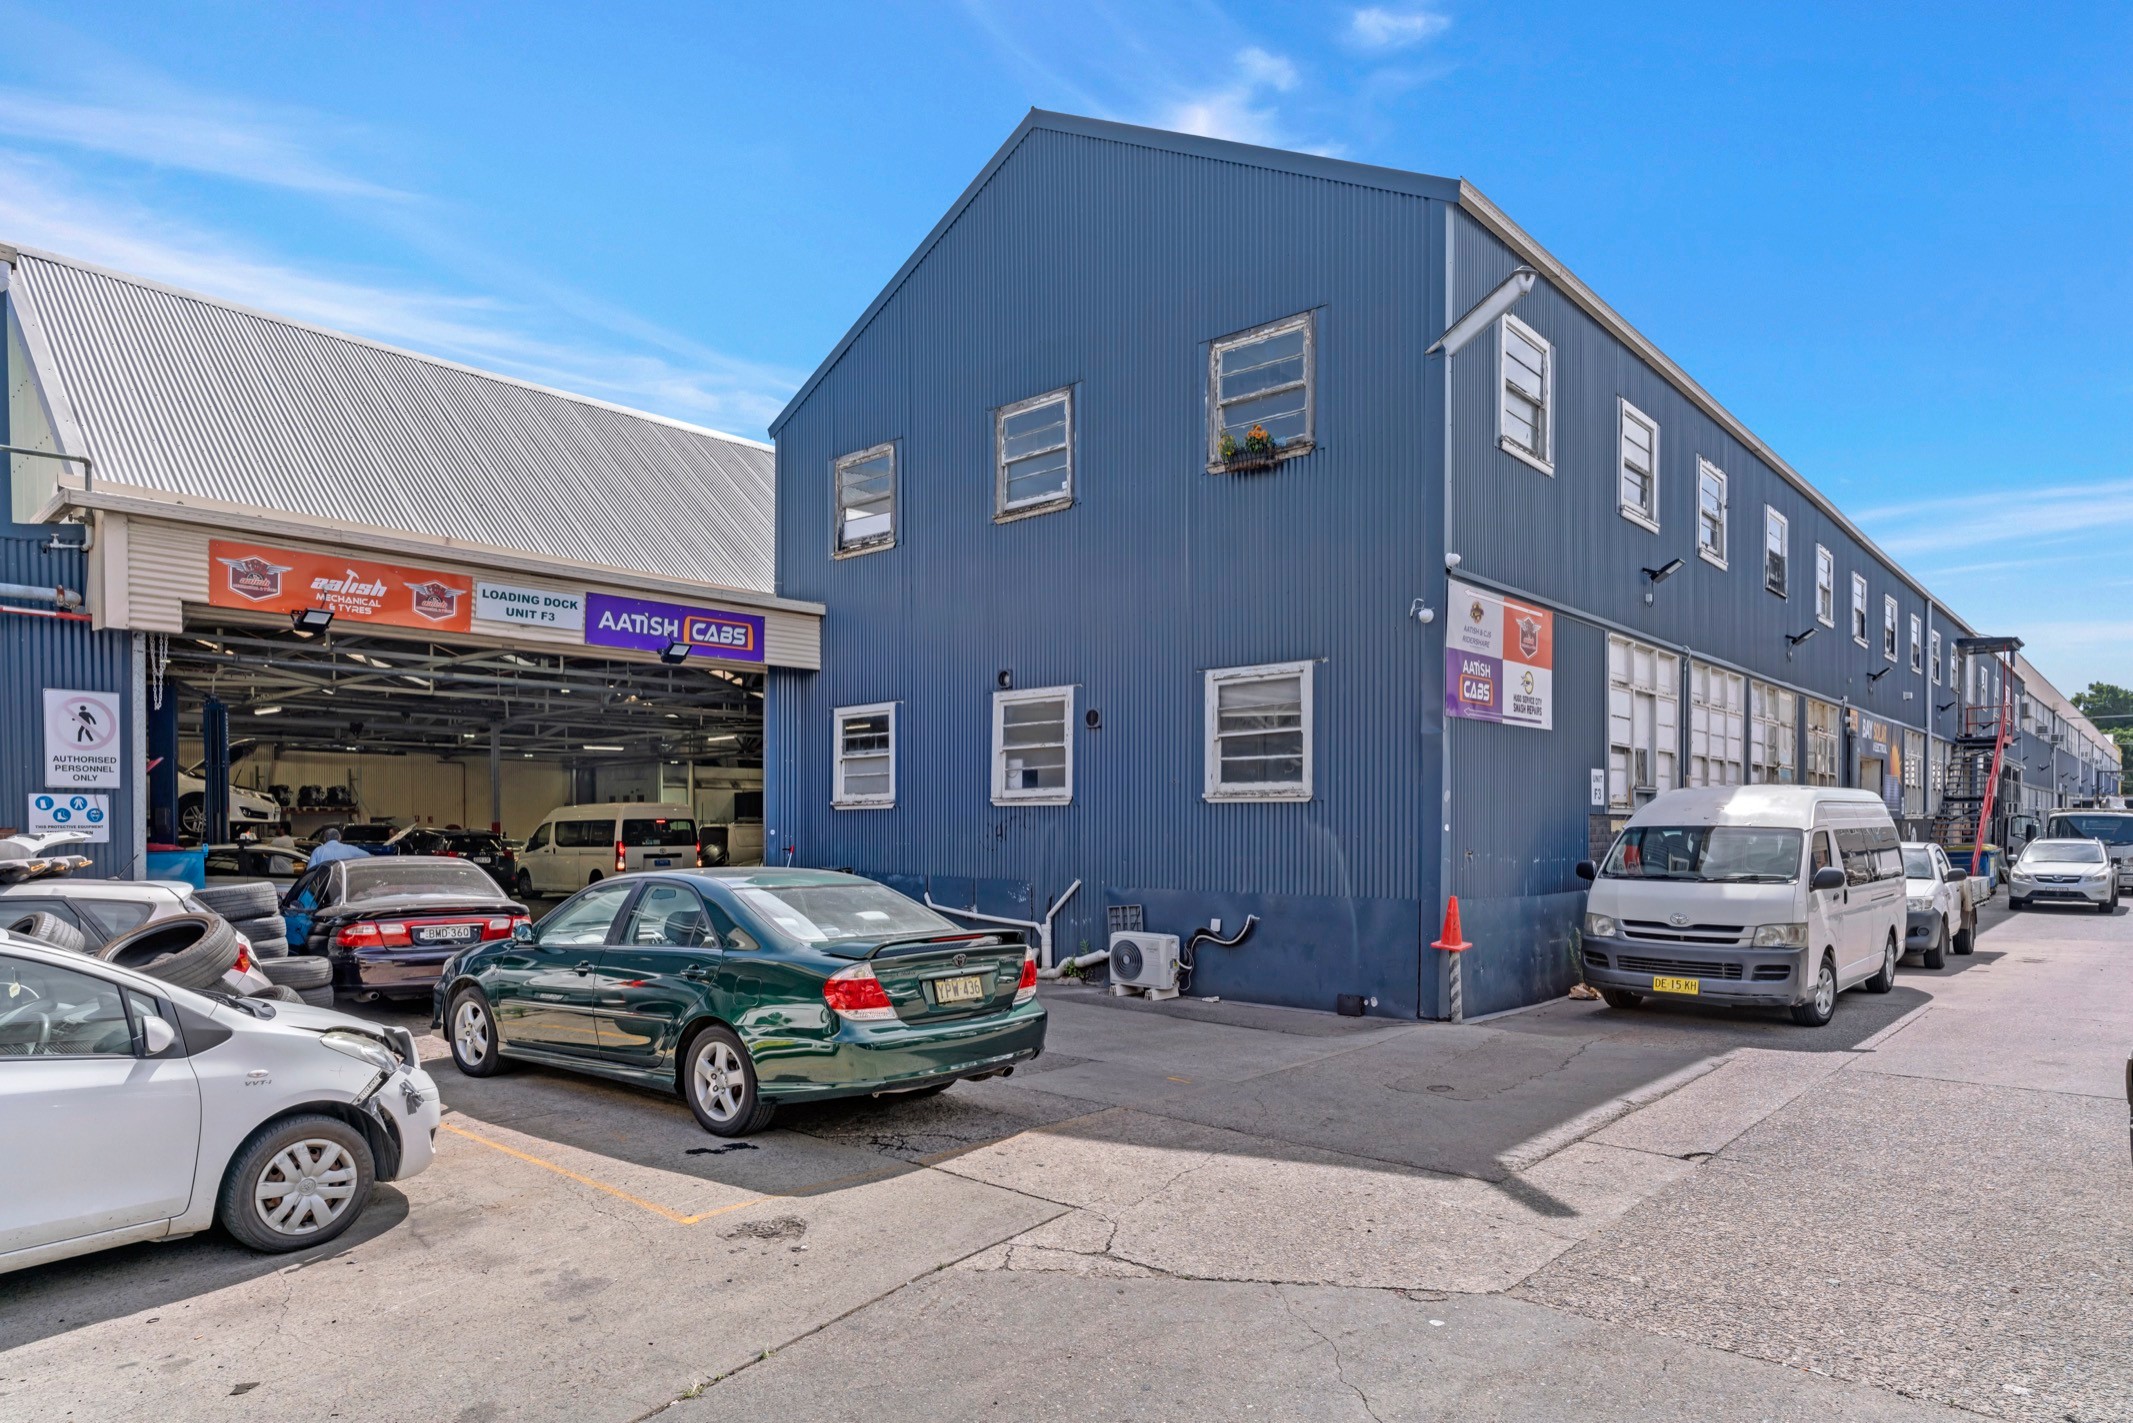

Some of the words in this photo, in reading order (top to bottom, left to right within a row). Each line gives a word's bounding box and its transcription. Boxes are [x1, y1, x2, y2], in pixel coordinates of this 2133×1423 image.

[316, 593, 381, 607] MECHANICAL
[482, 588, 540, 605] LOADING
[543, 596, 578, 610] DOCK
[329, 603, 335, 611] &
[338, 604, 372, 615] TYRES
[505, 607, 537, 619] UNIT
[541, 610, 555, 622] F3
[598, 611, 679, 638] AATISH
[692, 622, 747, 646] CABS
[1462, 635, 1491, 648] RIDERSHARE
[1462, 659, 1491, 679] AATISH
[1463, 680, 1490, 702] CABS
[1513, 702, 1526, 714] SMASH
[1526, 704, 1543, 716] REPAIRS
[1862, 718, 1873, 739] BAY
[1873, 721, 1887, 743] SOLAR
[52, 755, 117, 764] AUTHORISED
[54, 765, 114, 773] PERSONNEL
[72, 773, 98, 782] ONLY
[1592, 775, 1603, 783] UNIT
[1594, 788, 1602, 800] F3
[1655, 978, 1667, 988] DE
[1671, 979, 1682, 990] 15
[1684, 980, 1697, 991] KH
